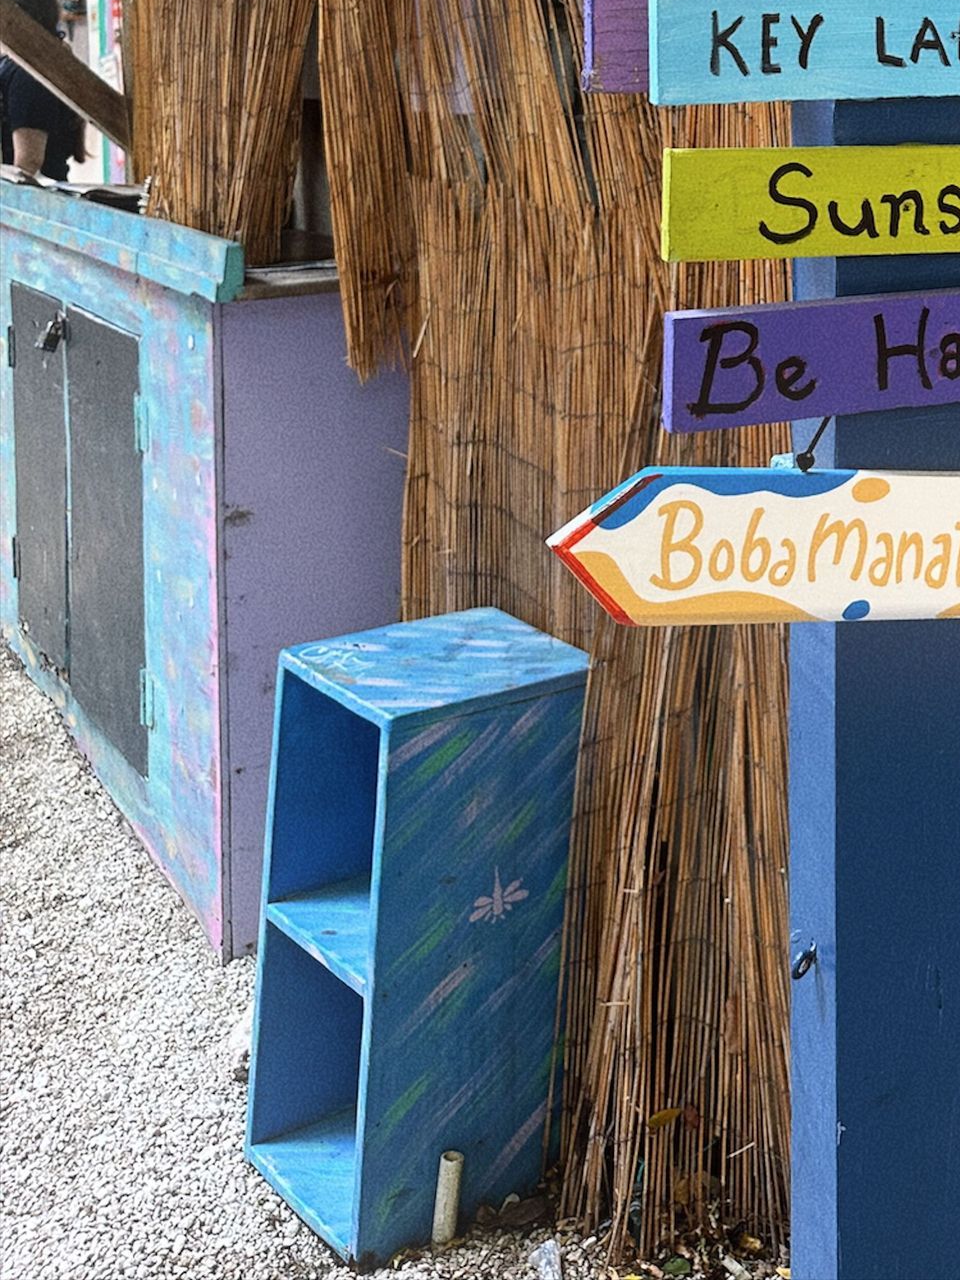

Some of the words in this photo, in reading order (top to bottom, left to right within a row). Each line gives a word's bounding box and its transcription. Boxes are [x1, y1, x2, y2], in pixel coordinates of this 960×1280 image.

[709, 10, 824, 76] KEY
[686, 320, 818, 418] Be
[648, 499, 797, 592] Boba
